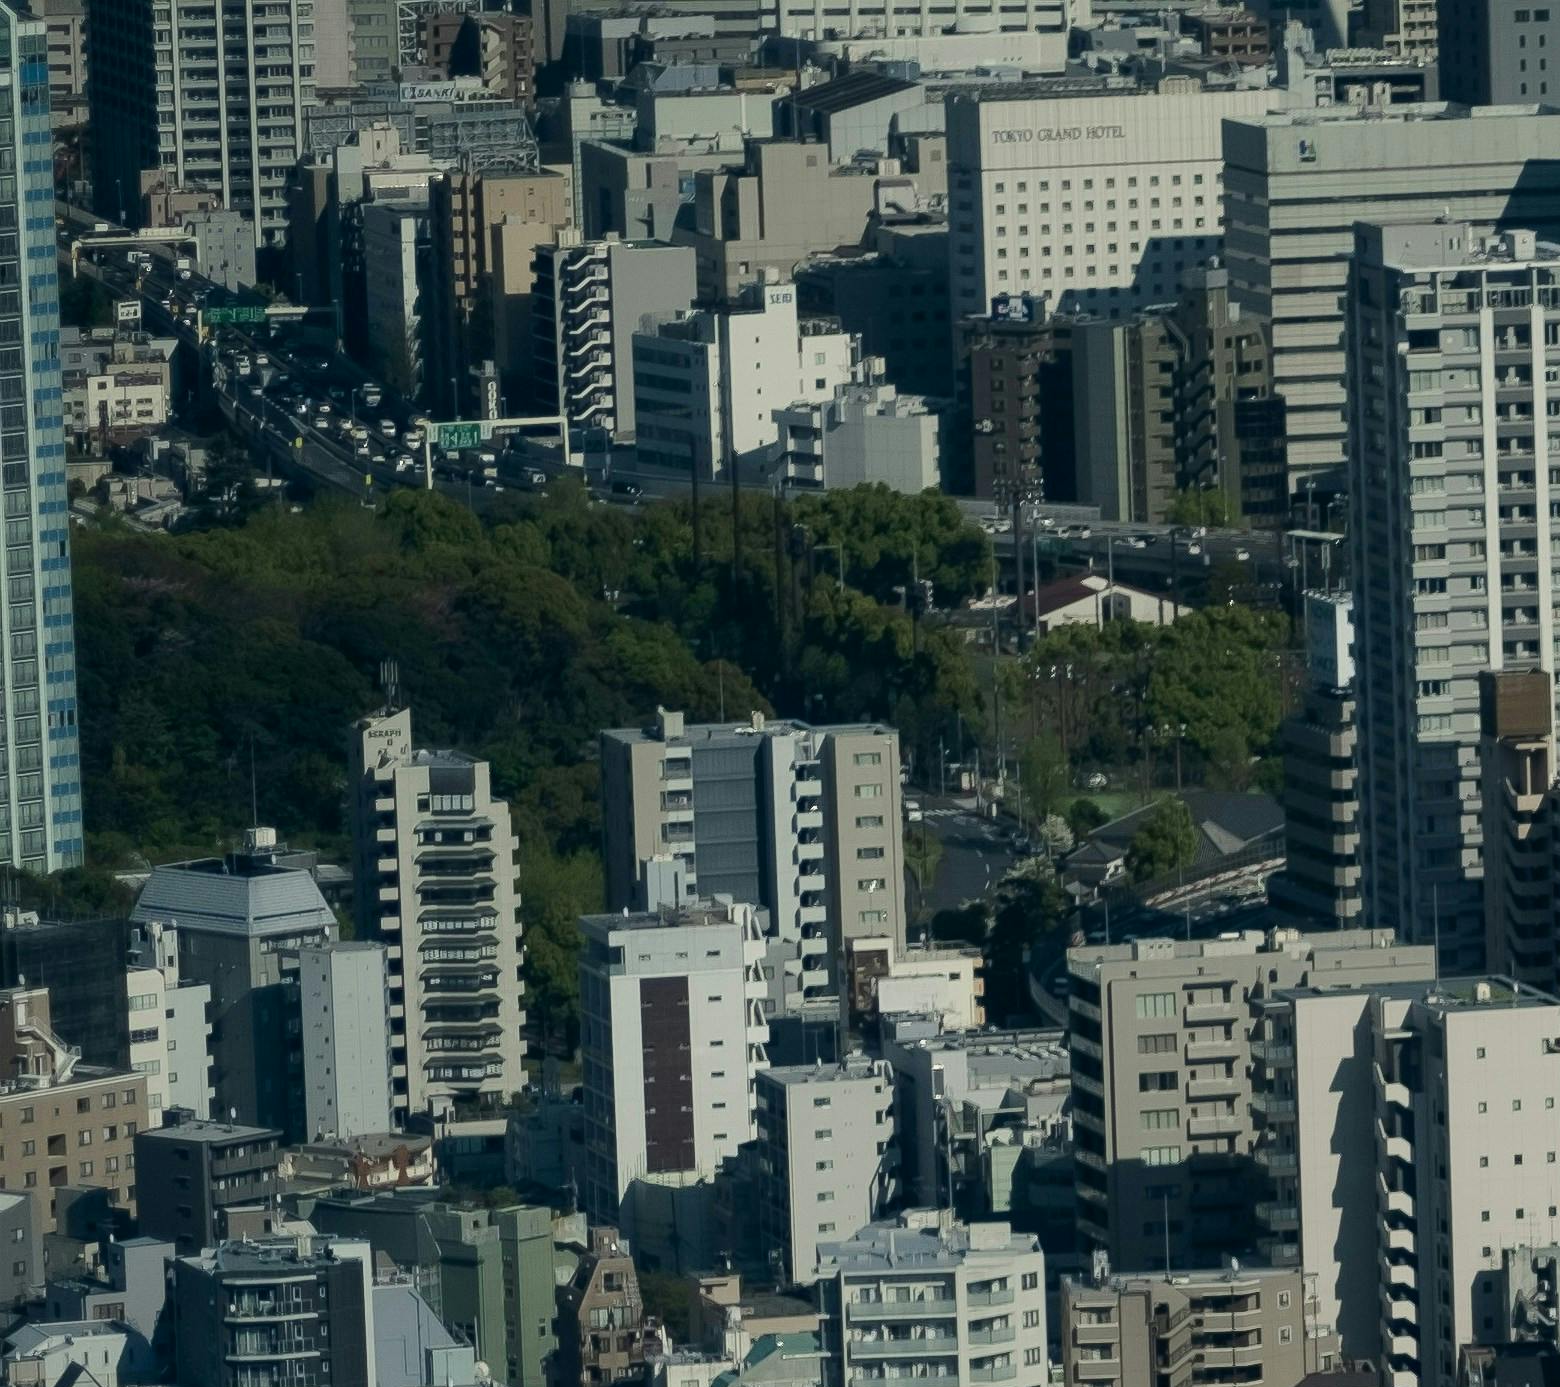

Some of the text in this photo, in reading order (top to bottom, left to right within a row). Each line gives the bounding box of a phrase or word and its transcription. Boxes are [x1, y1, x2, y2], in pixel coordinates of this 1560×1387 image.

[991, 126, 1125, 144] TOKYO GRAND HOTEL
